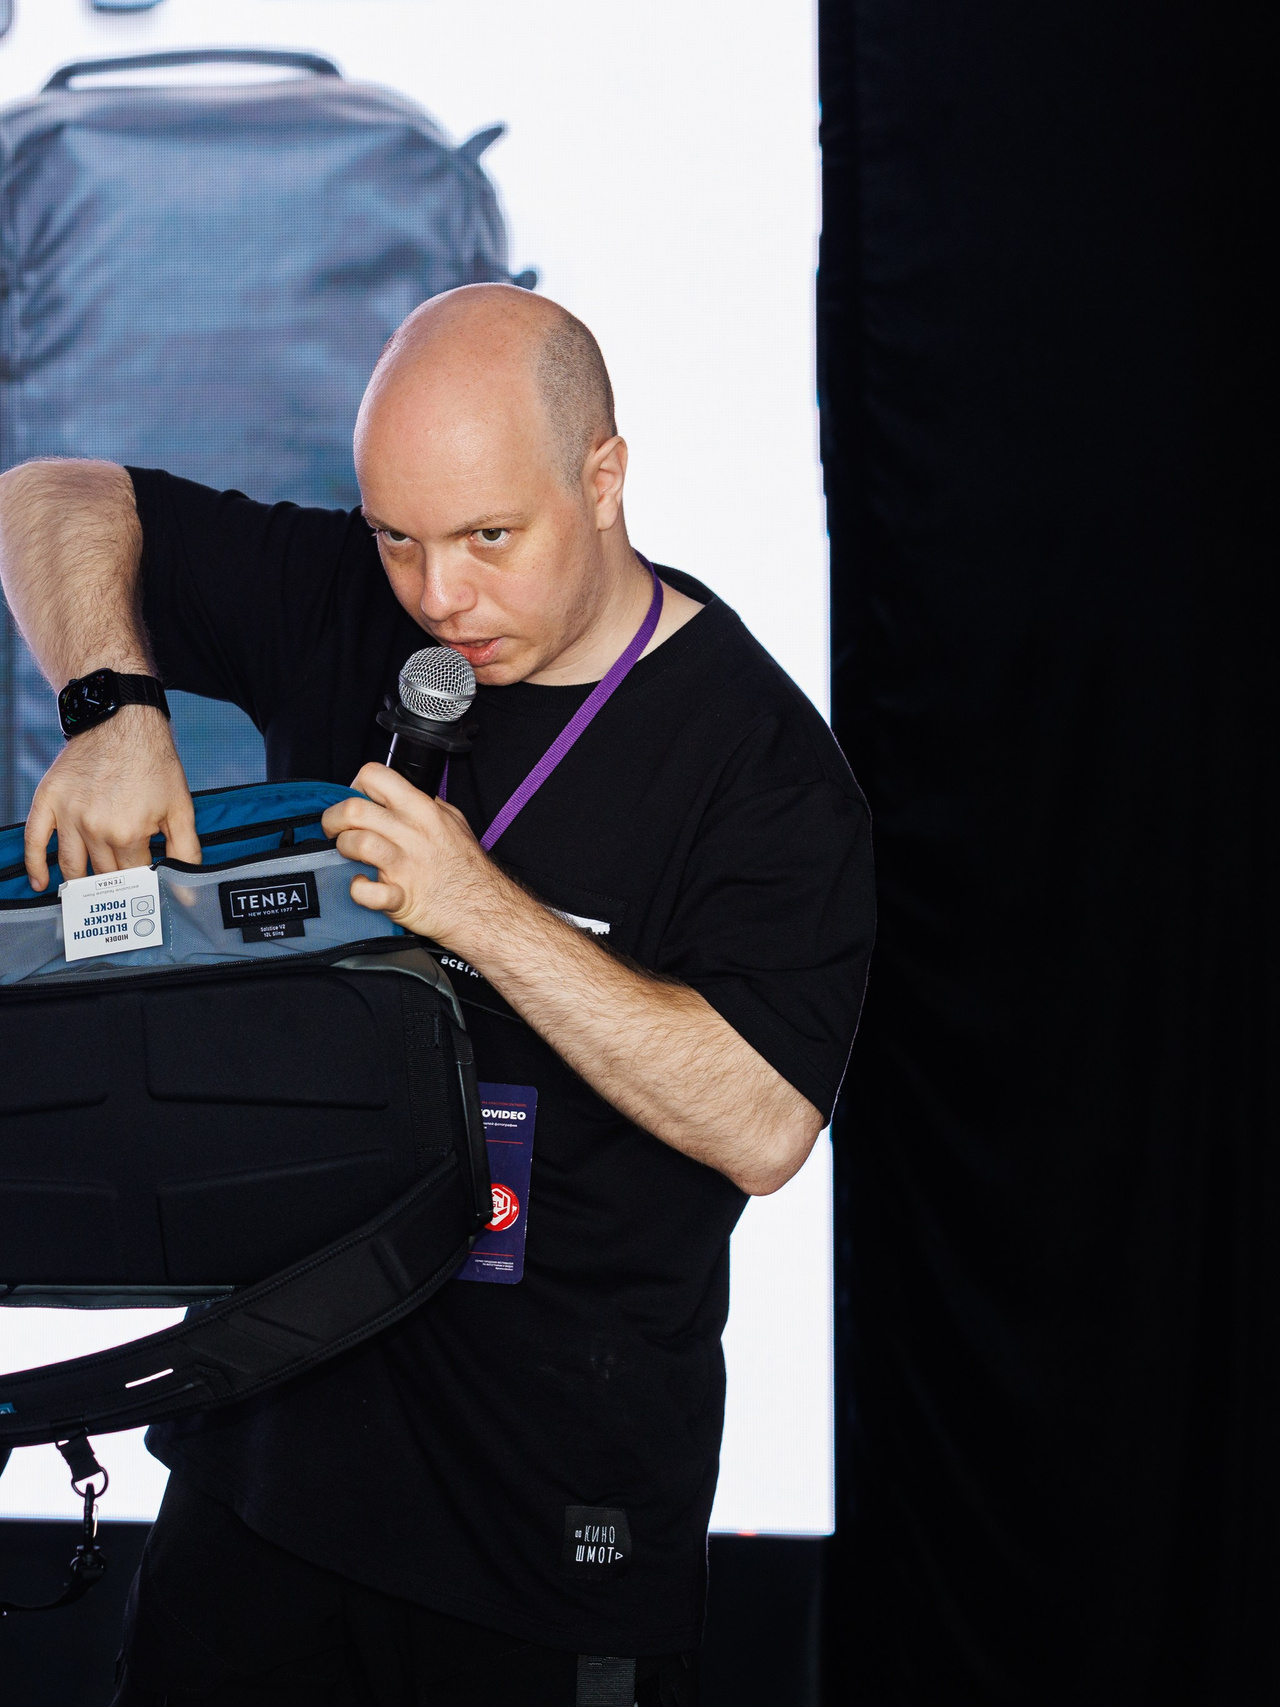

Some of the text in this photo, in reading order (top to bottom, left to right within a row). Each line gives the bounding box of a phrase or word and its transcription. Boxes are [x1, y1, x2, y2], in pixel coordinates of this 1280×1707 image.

[98, 879, 122, 887] TENBA
[90, 900, 126, 913] POCKET
[237, 890, 302, 910] TENBA
[84, 911, 127, 926] TRACKER
[263, 908, 280, 916] YORK
[73, 922, 128, 940] BLUETOOTH
[105, 934, 129, 943] HIDDEN
[440, 955, 483, 978] ВСЕГД
[481, 1109, 527, 1120] OVIDEO
[584, 1525, 616, 1544] КИНО
[575, 1545, 615, 1564] ШМОТ
